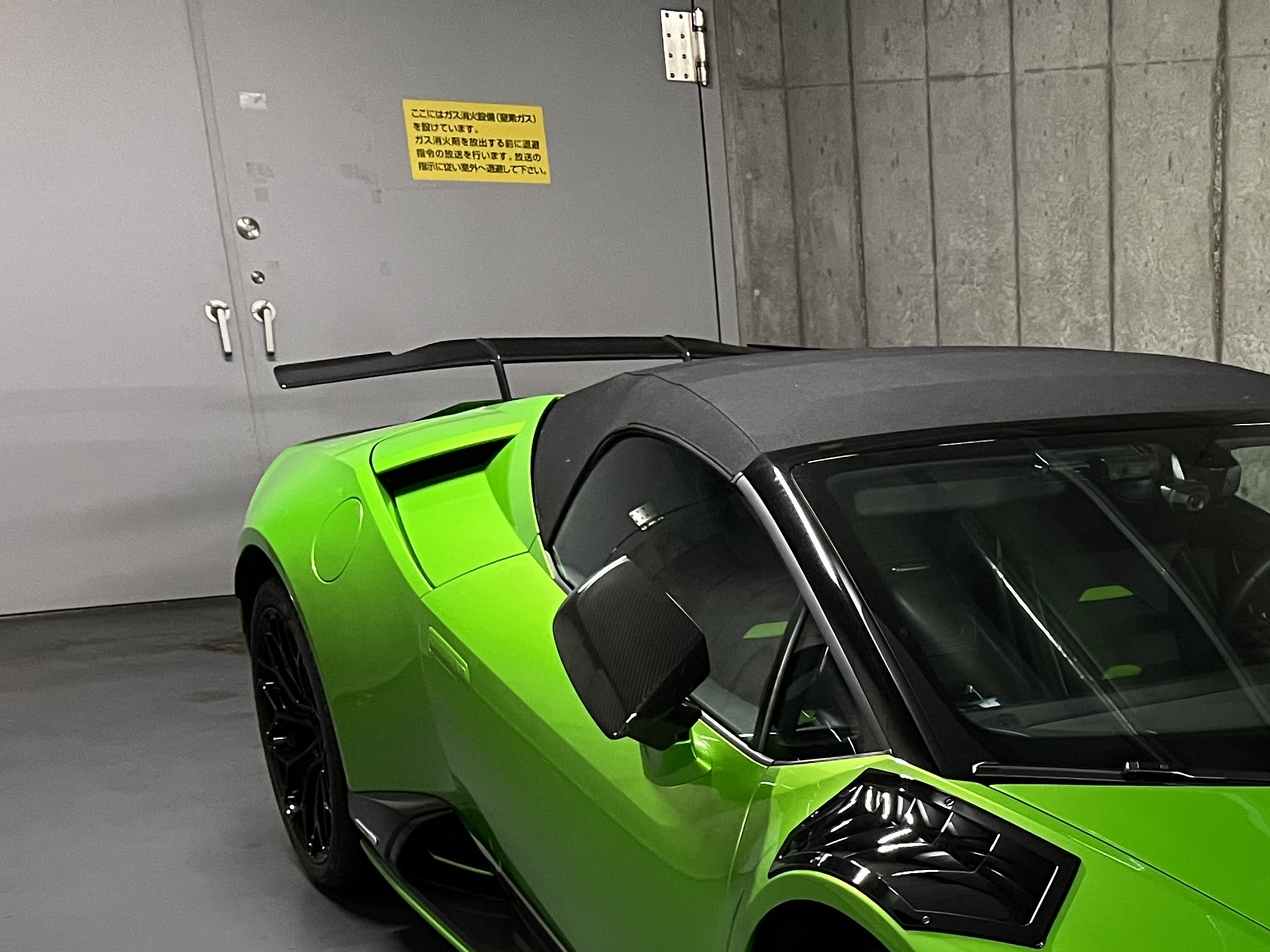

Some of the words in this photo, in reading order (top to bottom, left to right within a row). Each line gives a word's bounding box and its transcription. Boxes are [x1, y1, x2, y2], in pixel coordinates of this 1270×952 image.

[413, 121, 479, 134] を設けています。
[415, 136, 540, 150] ガス消火剤を放出する前に退避
[416, 147, 542, 162] 指令の放送を行います。放送の
